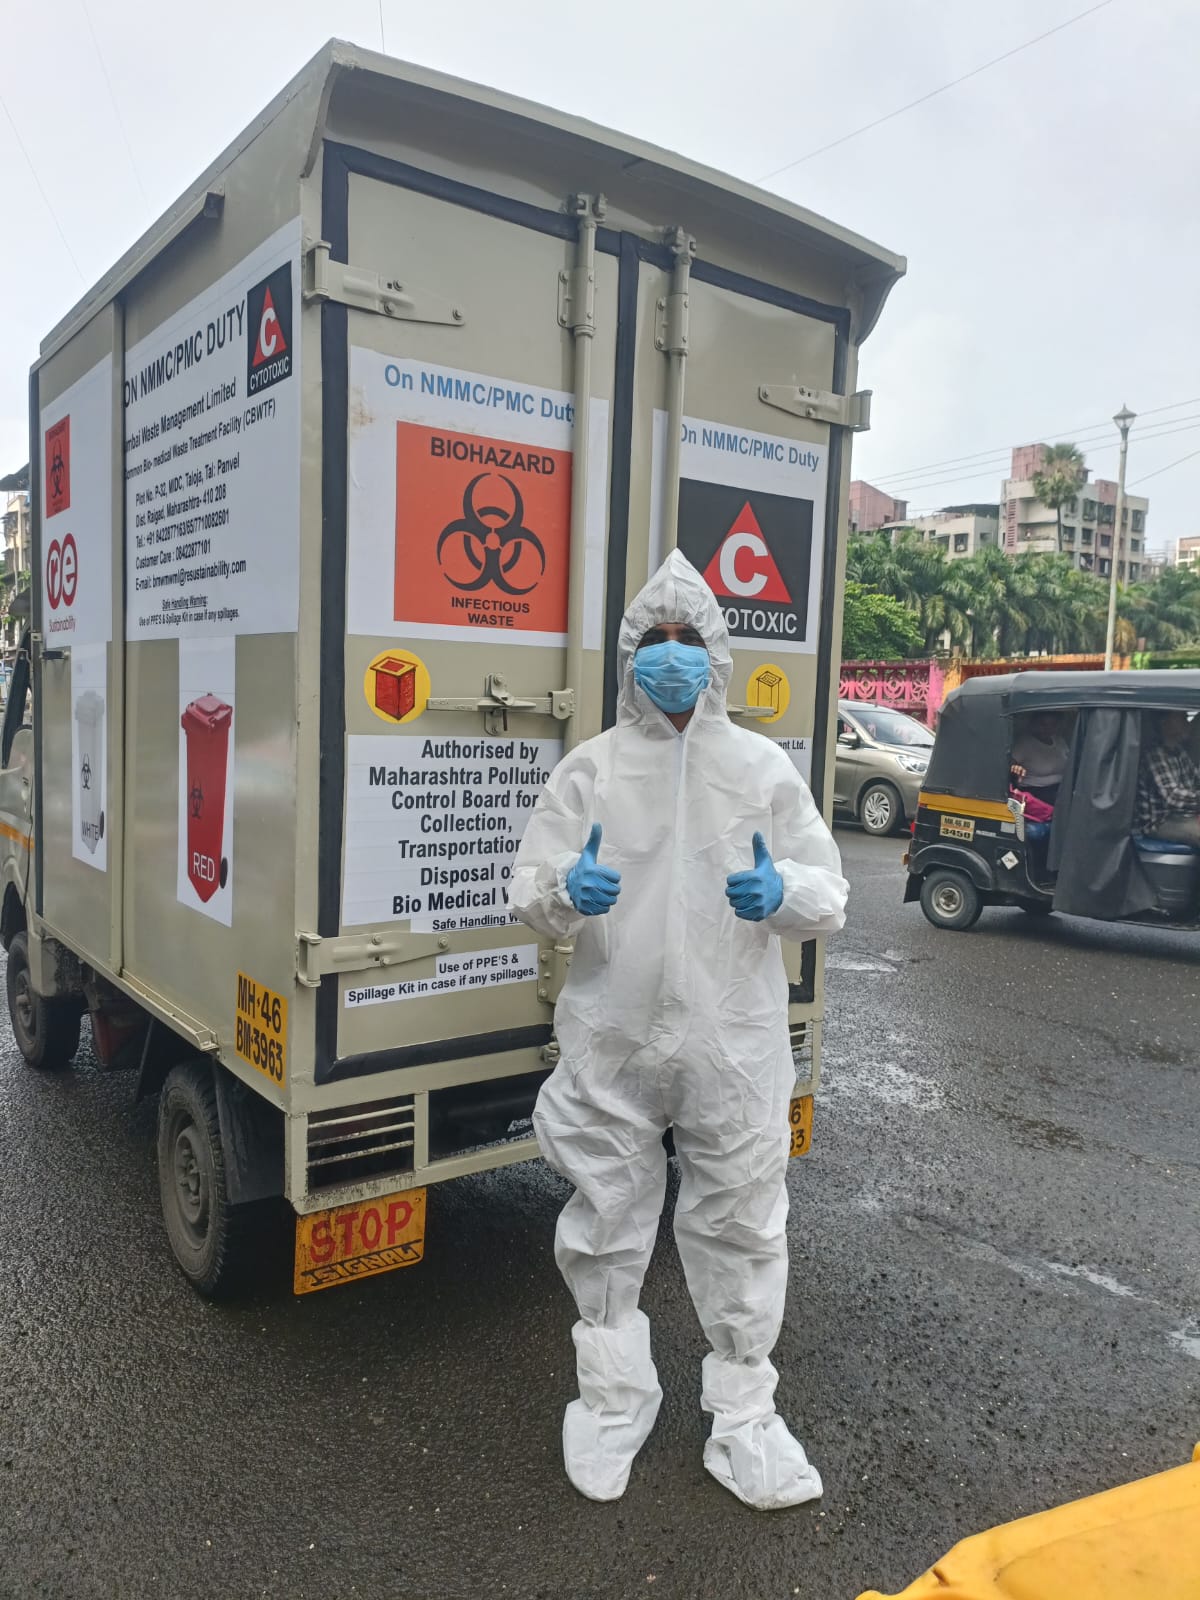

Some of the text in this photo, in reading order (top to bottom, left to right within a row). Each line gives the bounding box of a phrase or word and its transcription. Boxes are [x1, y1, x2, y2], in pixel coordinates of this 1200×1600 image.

[260, 307, 277, 358] C
[140, 330, 203, 398] NMMC/PMC
[207, 299, 245, 356] DUTY
[250, 356, 289, 390] CYTOTOXIC
[384, 364, 413, 392] On
[420, 371, 535, 414] NMMC/PMC
[142, 422, 160, 444] Waste
[161, 397, 204, 433] Management
[206, 376, 236, 410] Limited
[153, 447, 172, 467] medical
[189, 427, 217, 450] Treatment
[218, 414, 242, 436] Facility
[243, 397, 276, 431] (CBWTF)
[430, 436, 556, 476] BIOHAZARD
[702, 430, 784, 462] NMMC/PMC
[789, 447, 819, 473] Duty
[205, 461, 215, 480] Tal:
[217, 451, 240, 475] Panvel
[203, 487, 214, 504] 410
[214, 483, 227, 502] 208
[136, 553, 159, 570] Customer
[159, 550, 172, 565] Care
[720, 532, 768, 597] C
[451, 596, 531, 614] INFECTIOUS
[49, 615, 76, 633] Sustainability
[467, 613, 514, 627] WASTE
[421, 740, 539, 764] Authorised by
[792, 739, 806, 750] Ltd.
[370, 766, 550, 786] Maharashtra Pollutio
[391, 789, 539, 810] Control Board for
[81, 820, 99, 841] WHITE
[420, 813, 512, 834] Collection,
[193, 852, 215, 882] RED
[420, 863, 514, 888] Disposal o
[392, 894, 421, 914] Bio
[427, 888, 495, 912] Medical
[432, 917, 457, 931] Safe
[459, 914, 506, 929] Handling
[439, 953, 519, 974] Use of PPE'S &
[348, 966, 537, 1003] Spillage Kit in case if any spillages.
[310, 1200, 415, 1263] STOP
[301, 1239, 423, 1286] SIGNAL
